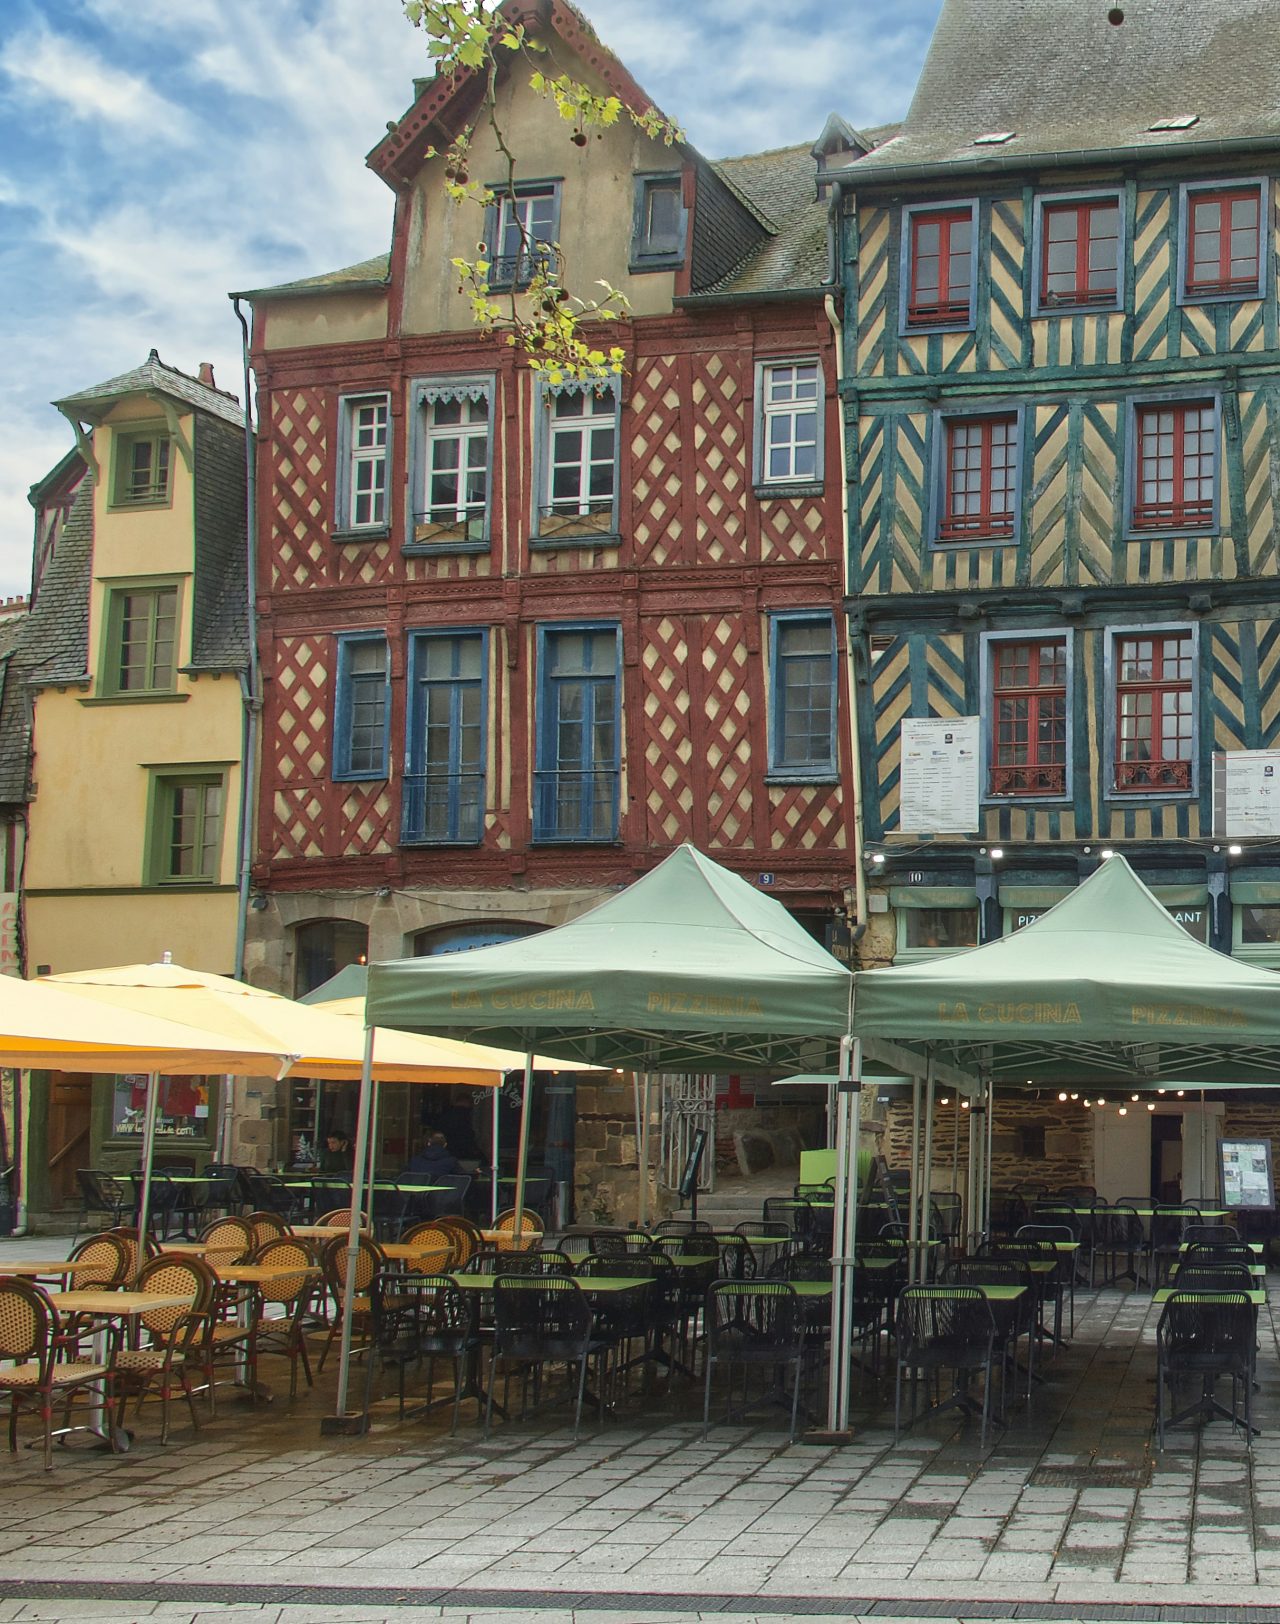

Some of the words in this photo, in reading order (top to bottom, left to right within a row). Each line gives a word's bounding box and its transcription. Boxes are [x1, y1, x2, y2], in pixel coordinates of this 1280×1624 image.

[763, 874, 770, 884] 9
[909, 872, 922, 883] 10
[1018, 915, 1041, 927] PIZ
[1169, 911, 1202, 923] ANT
[449, 989, 483, 1008] LA
[491, 989, 594, 1009] CUCINA
[648, 991, 762, 1016] PIZZERIA
[938, 1003, 968, 1023] LA
[978, 1003, 1082, 1024] CUCINA
[1132, 1005, 1248, 1027] PIZZERIA
